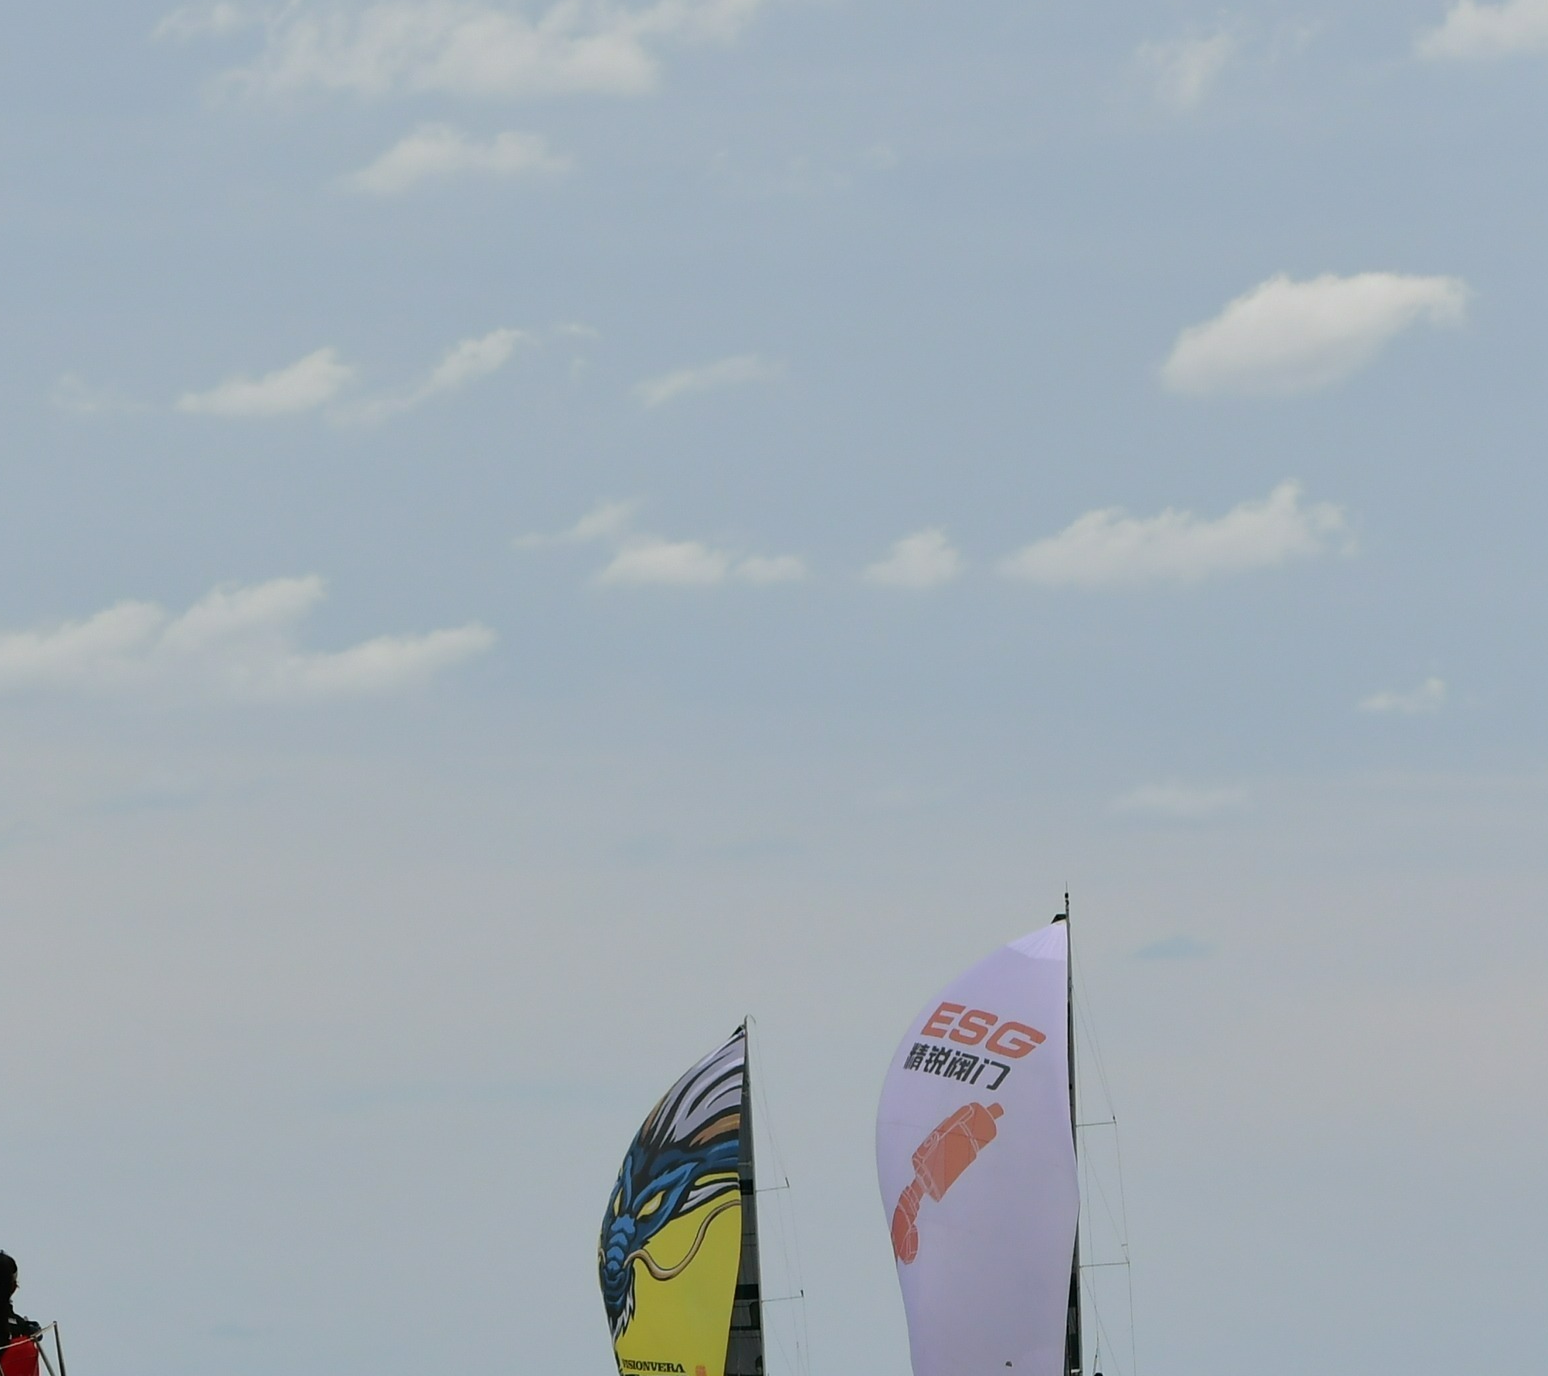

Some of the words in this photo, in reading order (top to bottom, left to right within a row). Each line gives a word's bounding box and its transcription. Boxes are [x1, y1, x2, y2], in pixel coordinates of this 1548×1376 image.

[920, 1001, 1047, 1059] ESG
[903, 1042, 1011, 1091] 精锐阀门
